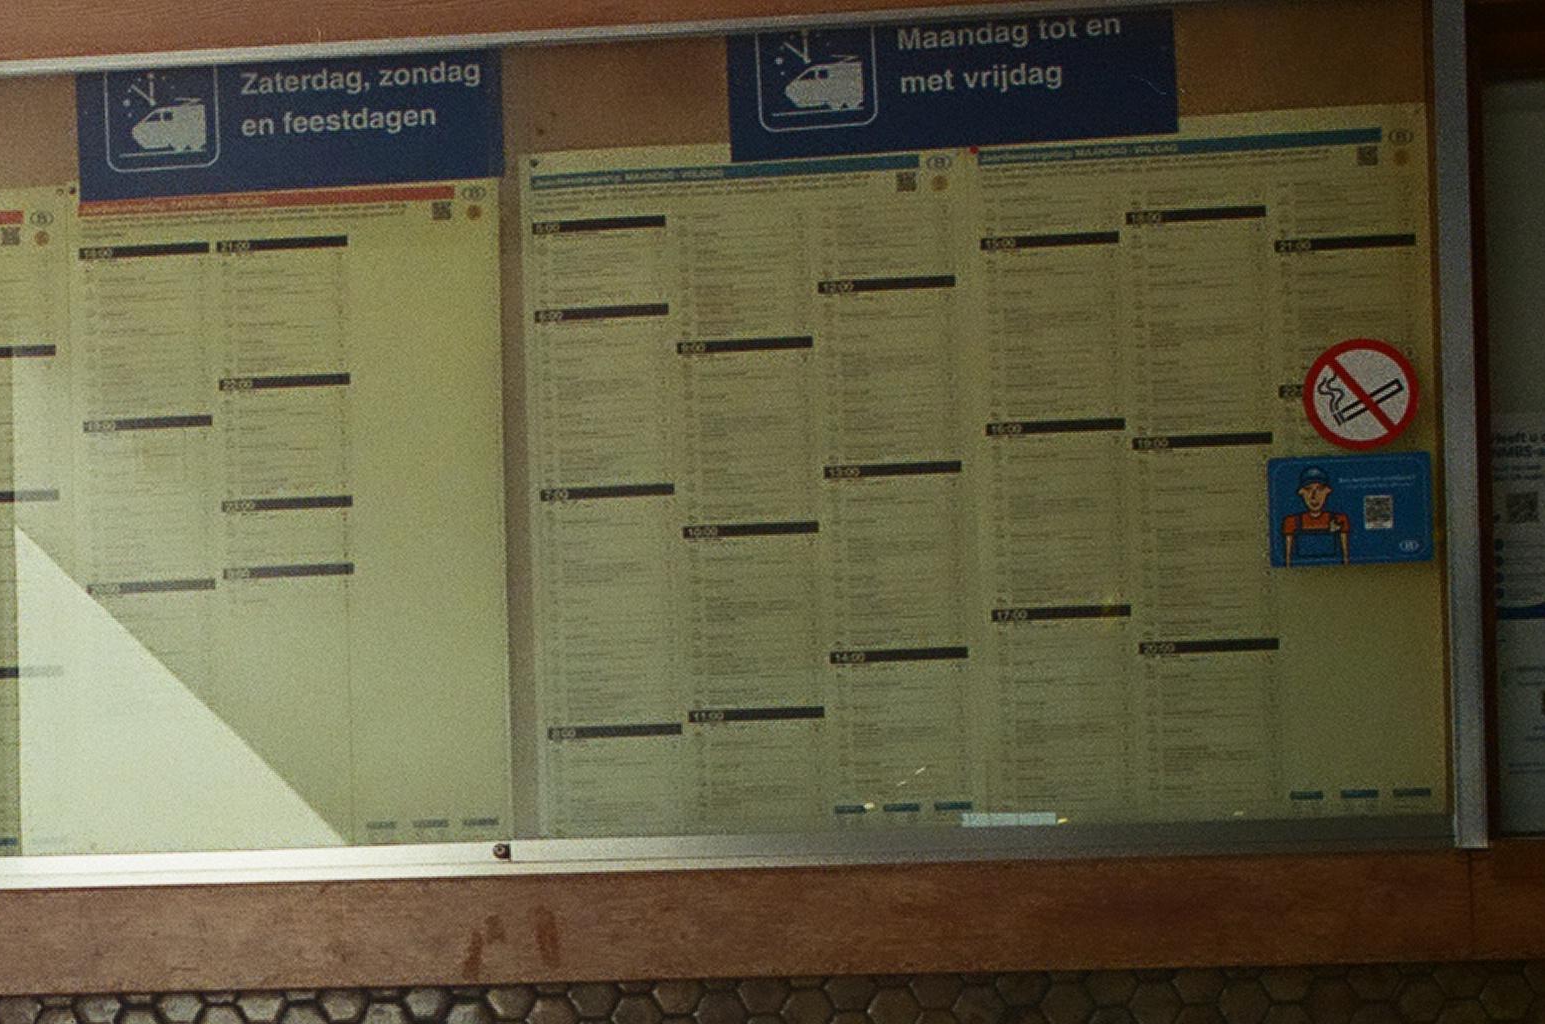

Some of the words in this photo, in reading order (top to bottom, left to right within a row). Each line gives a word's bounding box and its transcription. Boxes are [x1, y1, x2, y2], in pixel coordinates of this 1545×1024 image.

[897, 22, 1028, 51] Maandag
[1039, 18, 1076, 40] tot
[1086, 18, 1121, 37] en
[241, 67, 370, 96] Zaterdag,
[379, 62, 481, 88] zondag
[900, 70, 953, 94] met
[964, 62, 1063, 91] vrijdag
[241, 119, 275, 137] en
[283, 107, 436, 136] feestdagen
[1280, 241, 1311, 252] 21:00
[1282, 386, 1304, 397] 22:
[688, 527, 718, 537] 10:00
[997, 609, 1028, 620] 17:00
[692, 711, 724, 721] 11:00
